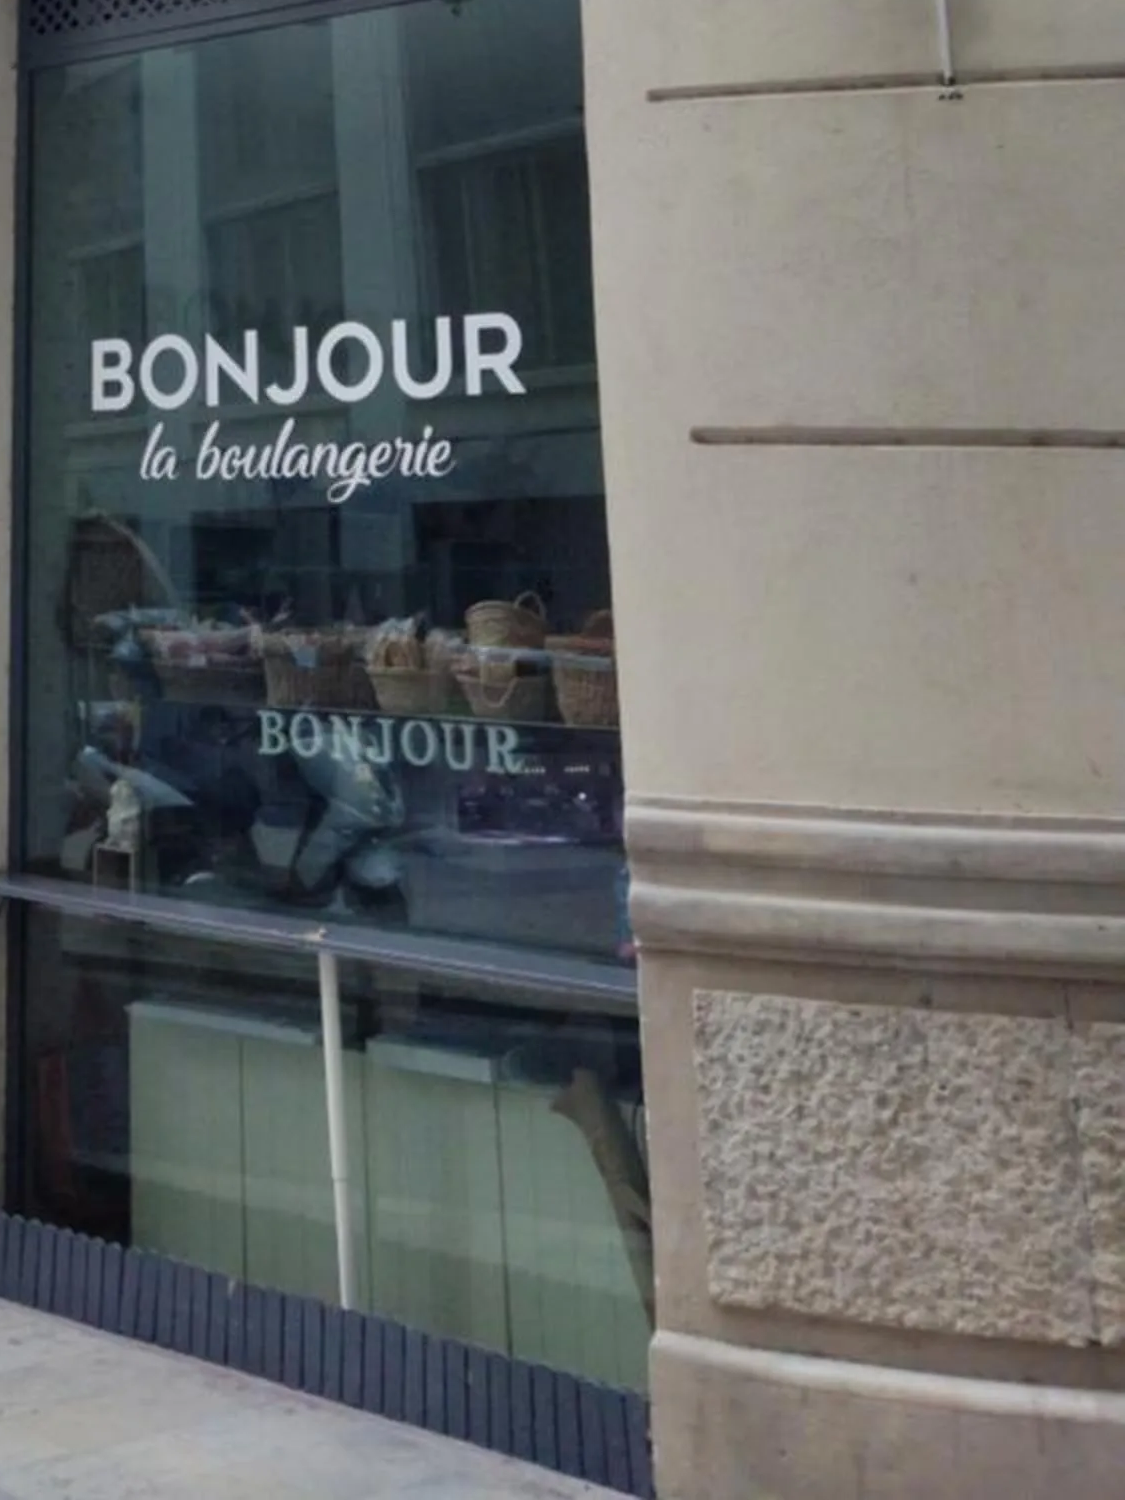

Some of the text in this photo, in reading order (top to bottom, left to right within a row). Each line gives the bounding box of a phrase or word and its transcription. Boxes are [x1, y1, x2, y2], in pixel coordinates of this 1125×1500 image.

[91, 312, 526, 412] BONJOUR
[140, 417, 456, 503] la boulangerie
[257, 709, 524, 775] BONJOUR
